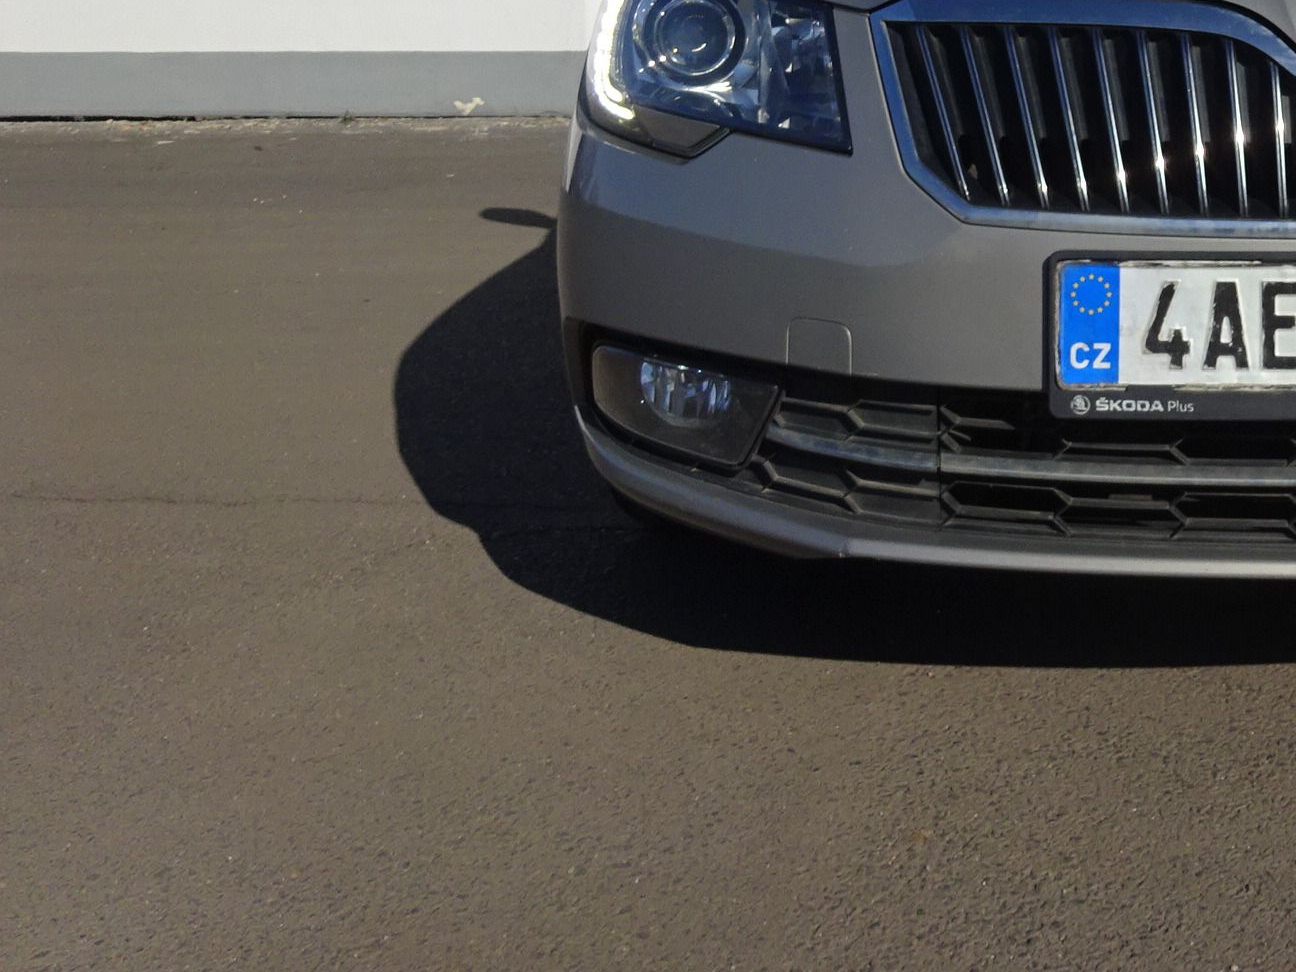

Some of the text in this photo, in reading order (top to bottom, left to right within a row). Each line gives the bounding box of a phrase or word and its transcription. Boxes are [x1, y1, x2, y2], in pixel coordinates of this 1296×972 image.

[1069, 341, 1112, 369] CZ
[1095, 396, 1195, 413] ŠKODA Plus
